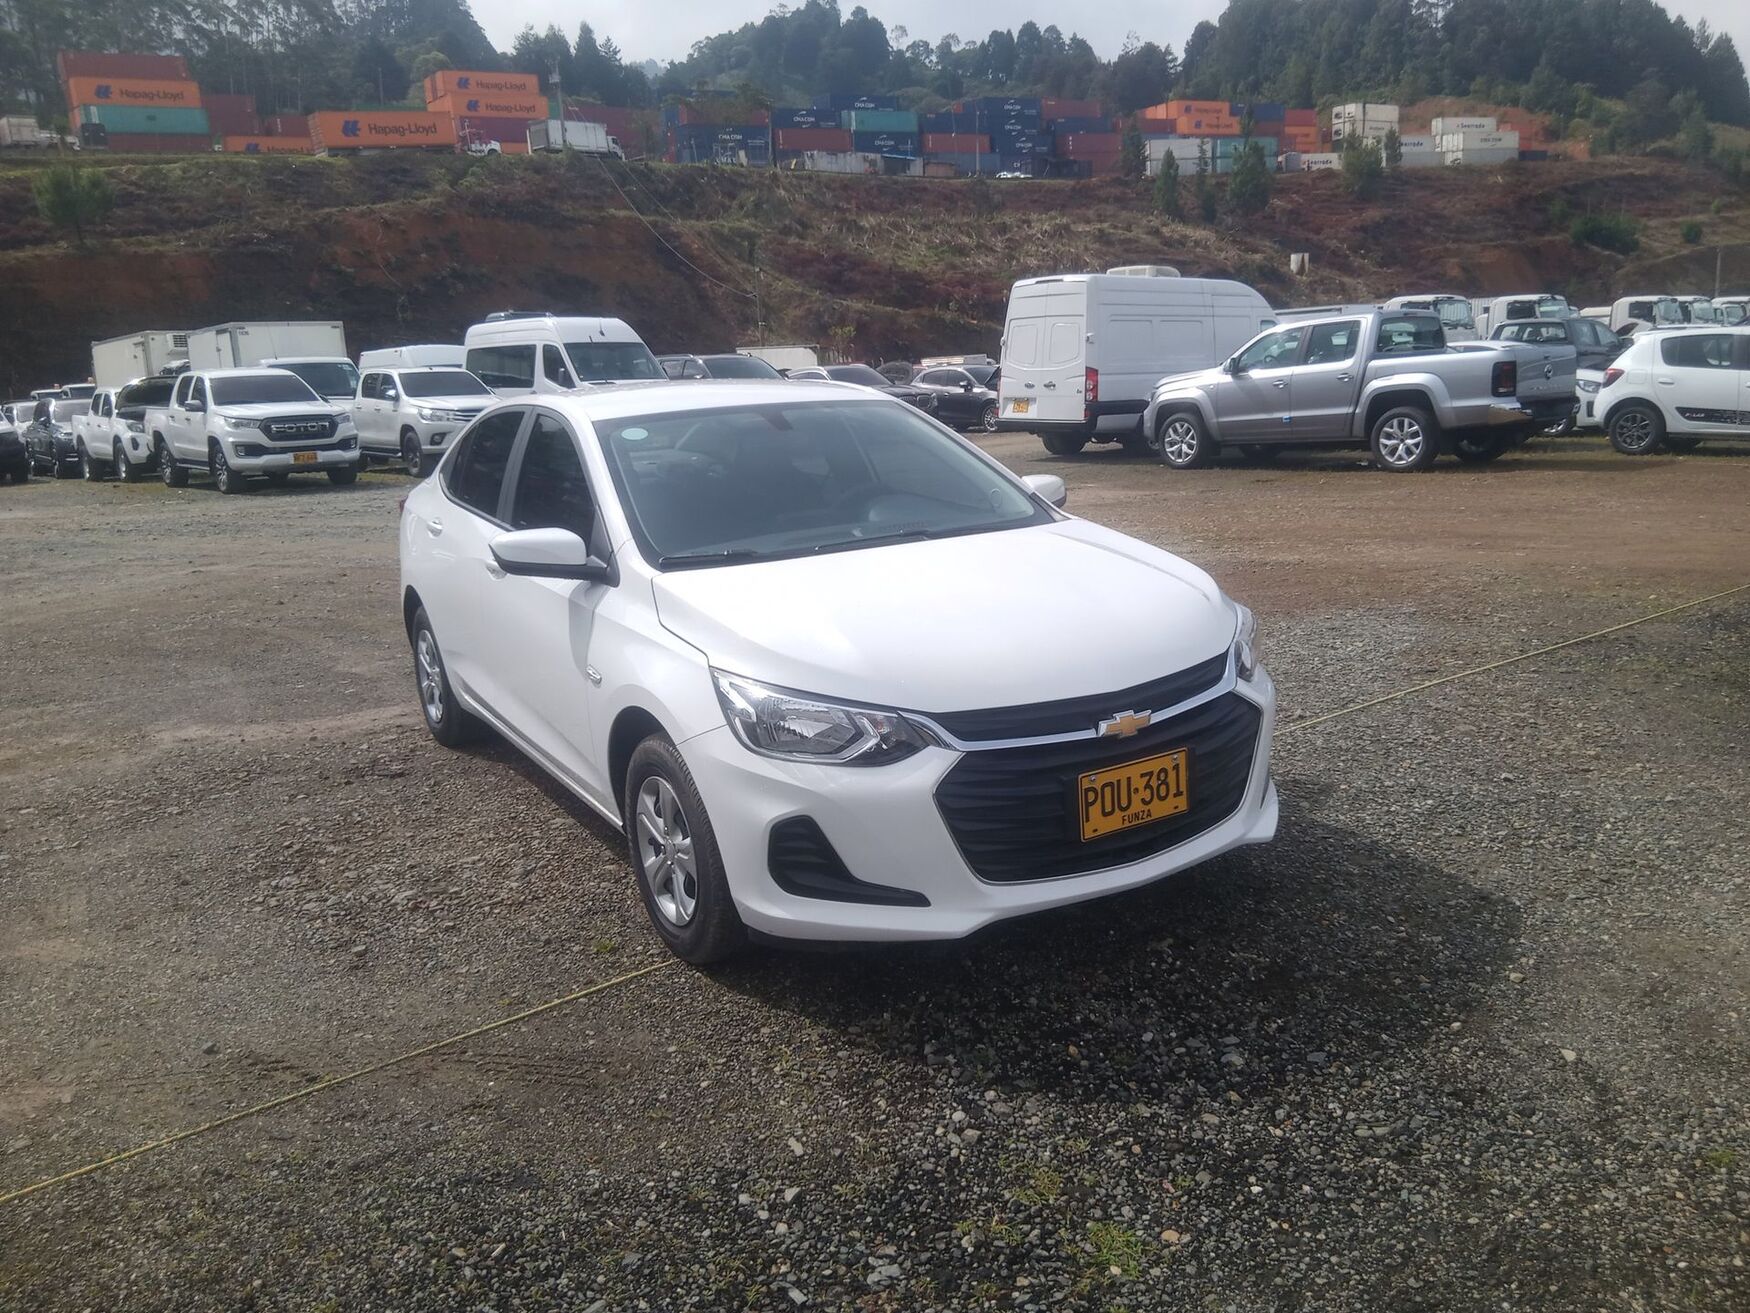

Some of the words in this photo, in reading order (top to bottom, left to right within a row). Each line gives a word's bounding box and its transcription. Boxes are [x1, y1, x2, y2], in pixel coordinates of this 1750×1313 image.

[476, 81, 527, 91] Hapag-Lloyd
[120, 87, 184, 102] Hapag-Lloyd
[485, 102, 536, 113] Hapag-Lloyd
[367, 123, 437, 136] Hapag-Lloyd
[271, 421, 329, 433] FOTON
[1122, 808, 1152, 825] FUNZA
